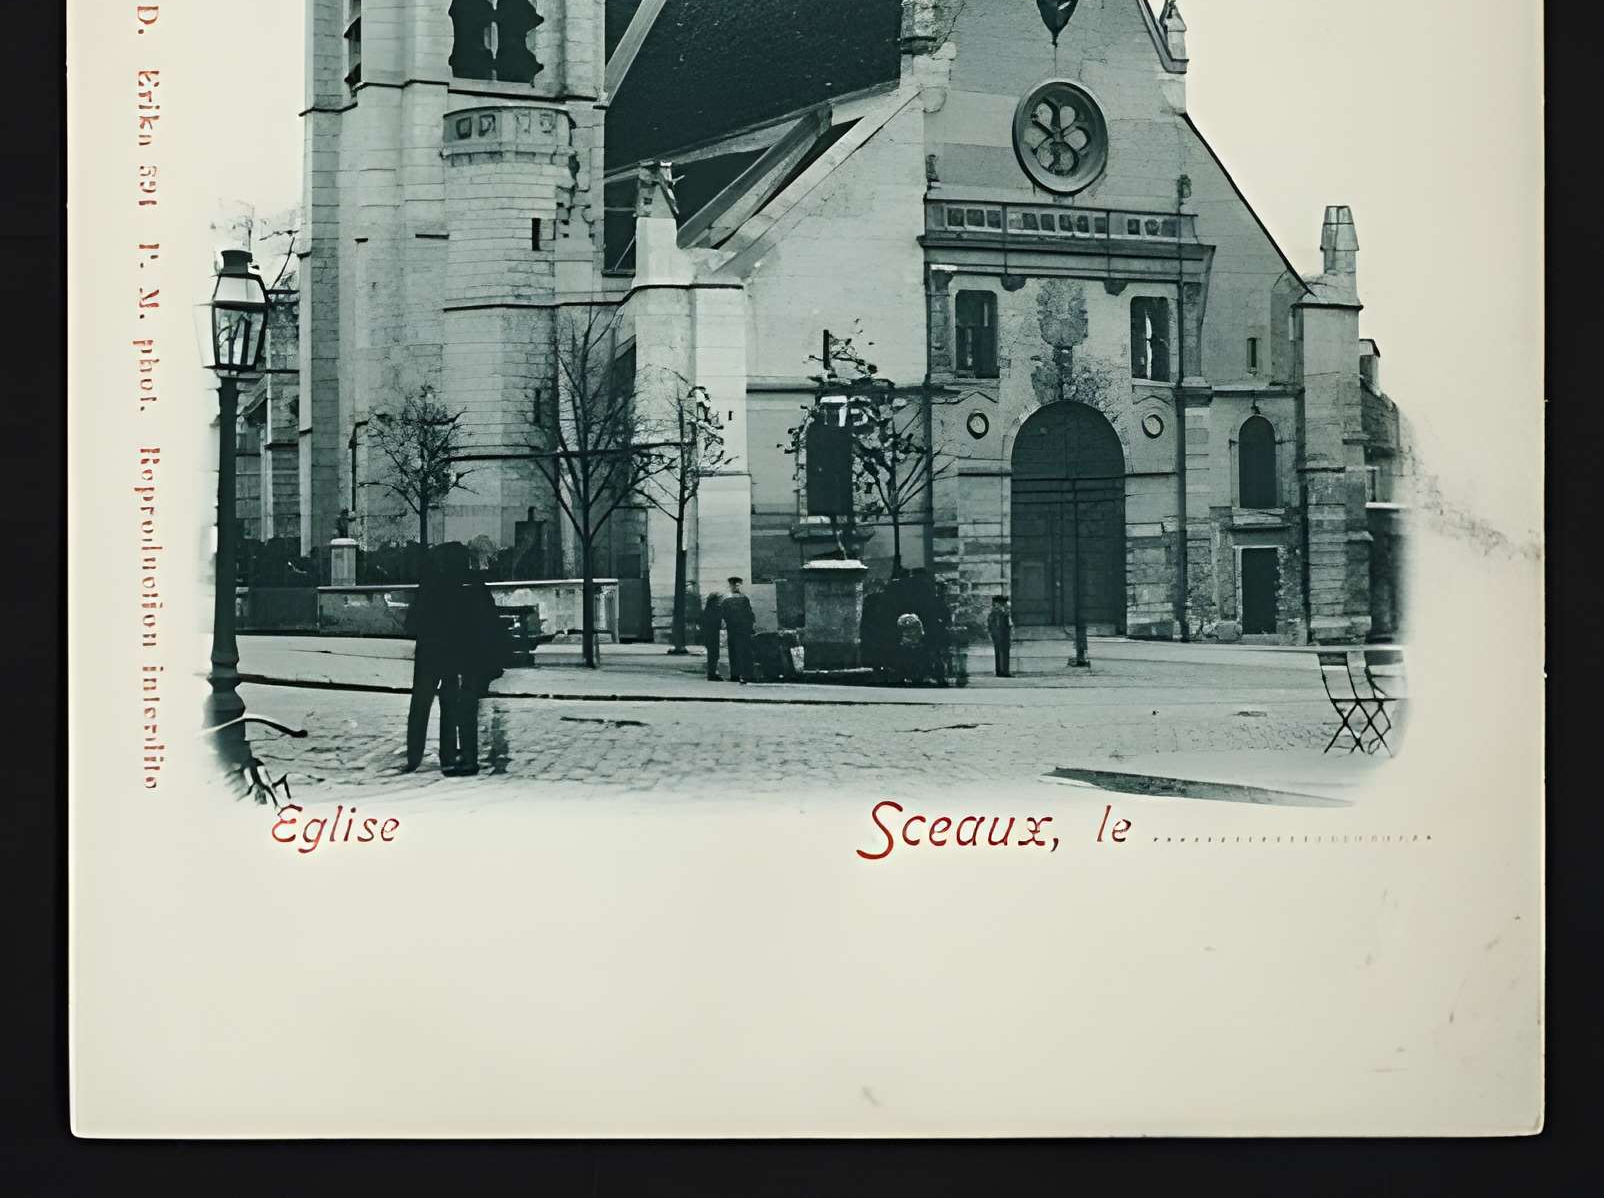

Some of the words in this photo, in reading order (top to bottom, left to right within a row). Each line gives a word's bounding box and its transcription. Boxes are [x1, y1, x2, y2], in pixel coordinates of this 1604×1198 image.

[136, 5, 160, 35] D.
[271, 803, 400, 854] Eglise
[856, 801, 1062, 859] Sceaux,
[1096, 805, 1132, 843] le
